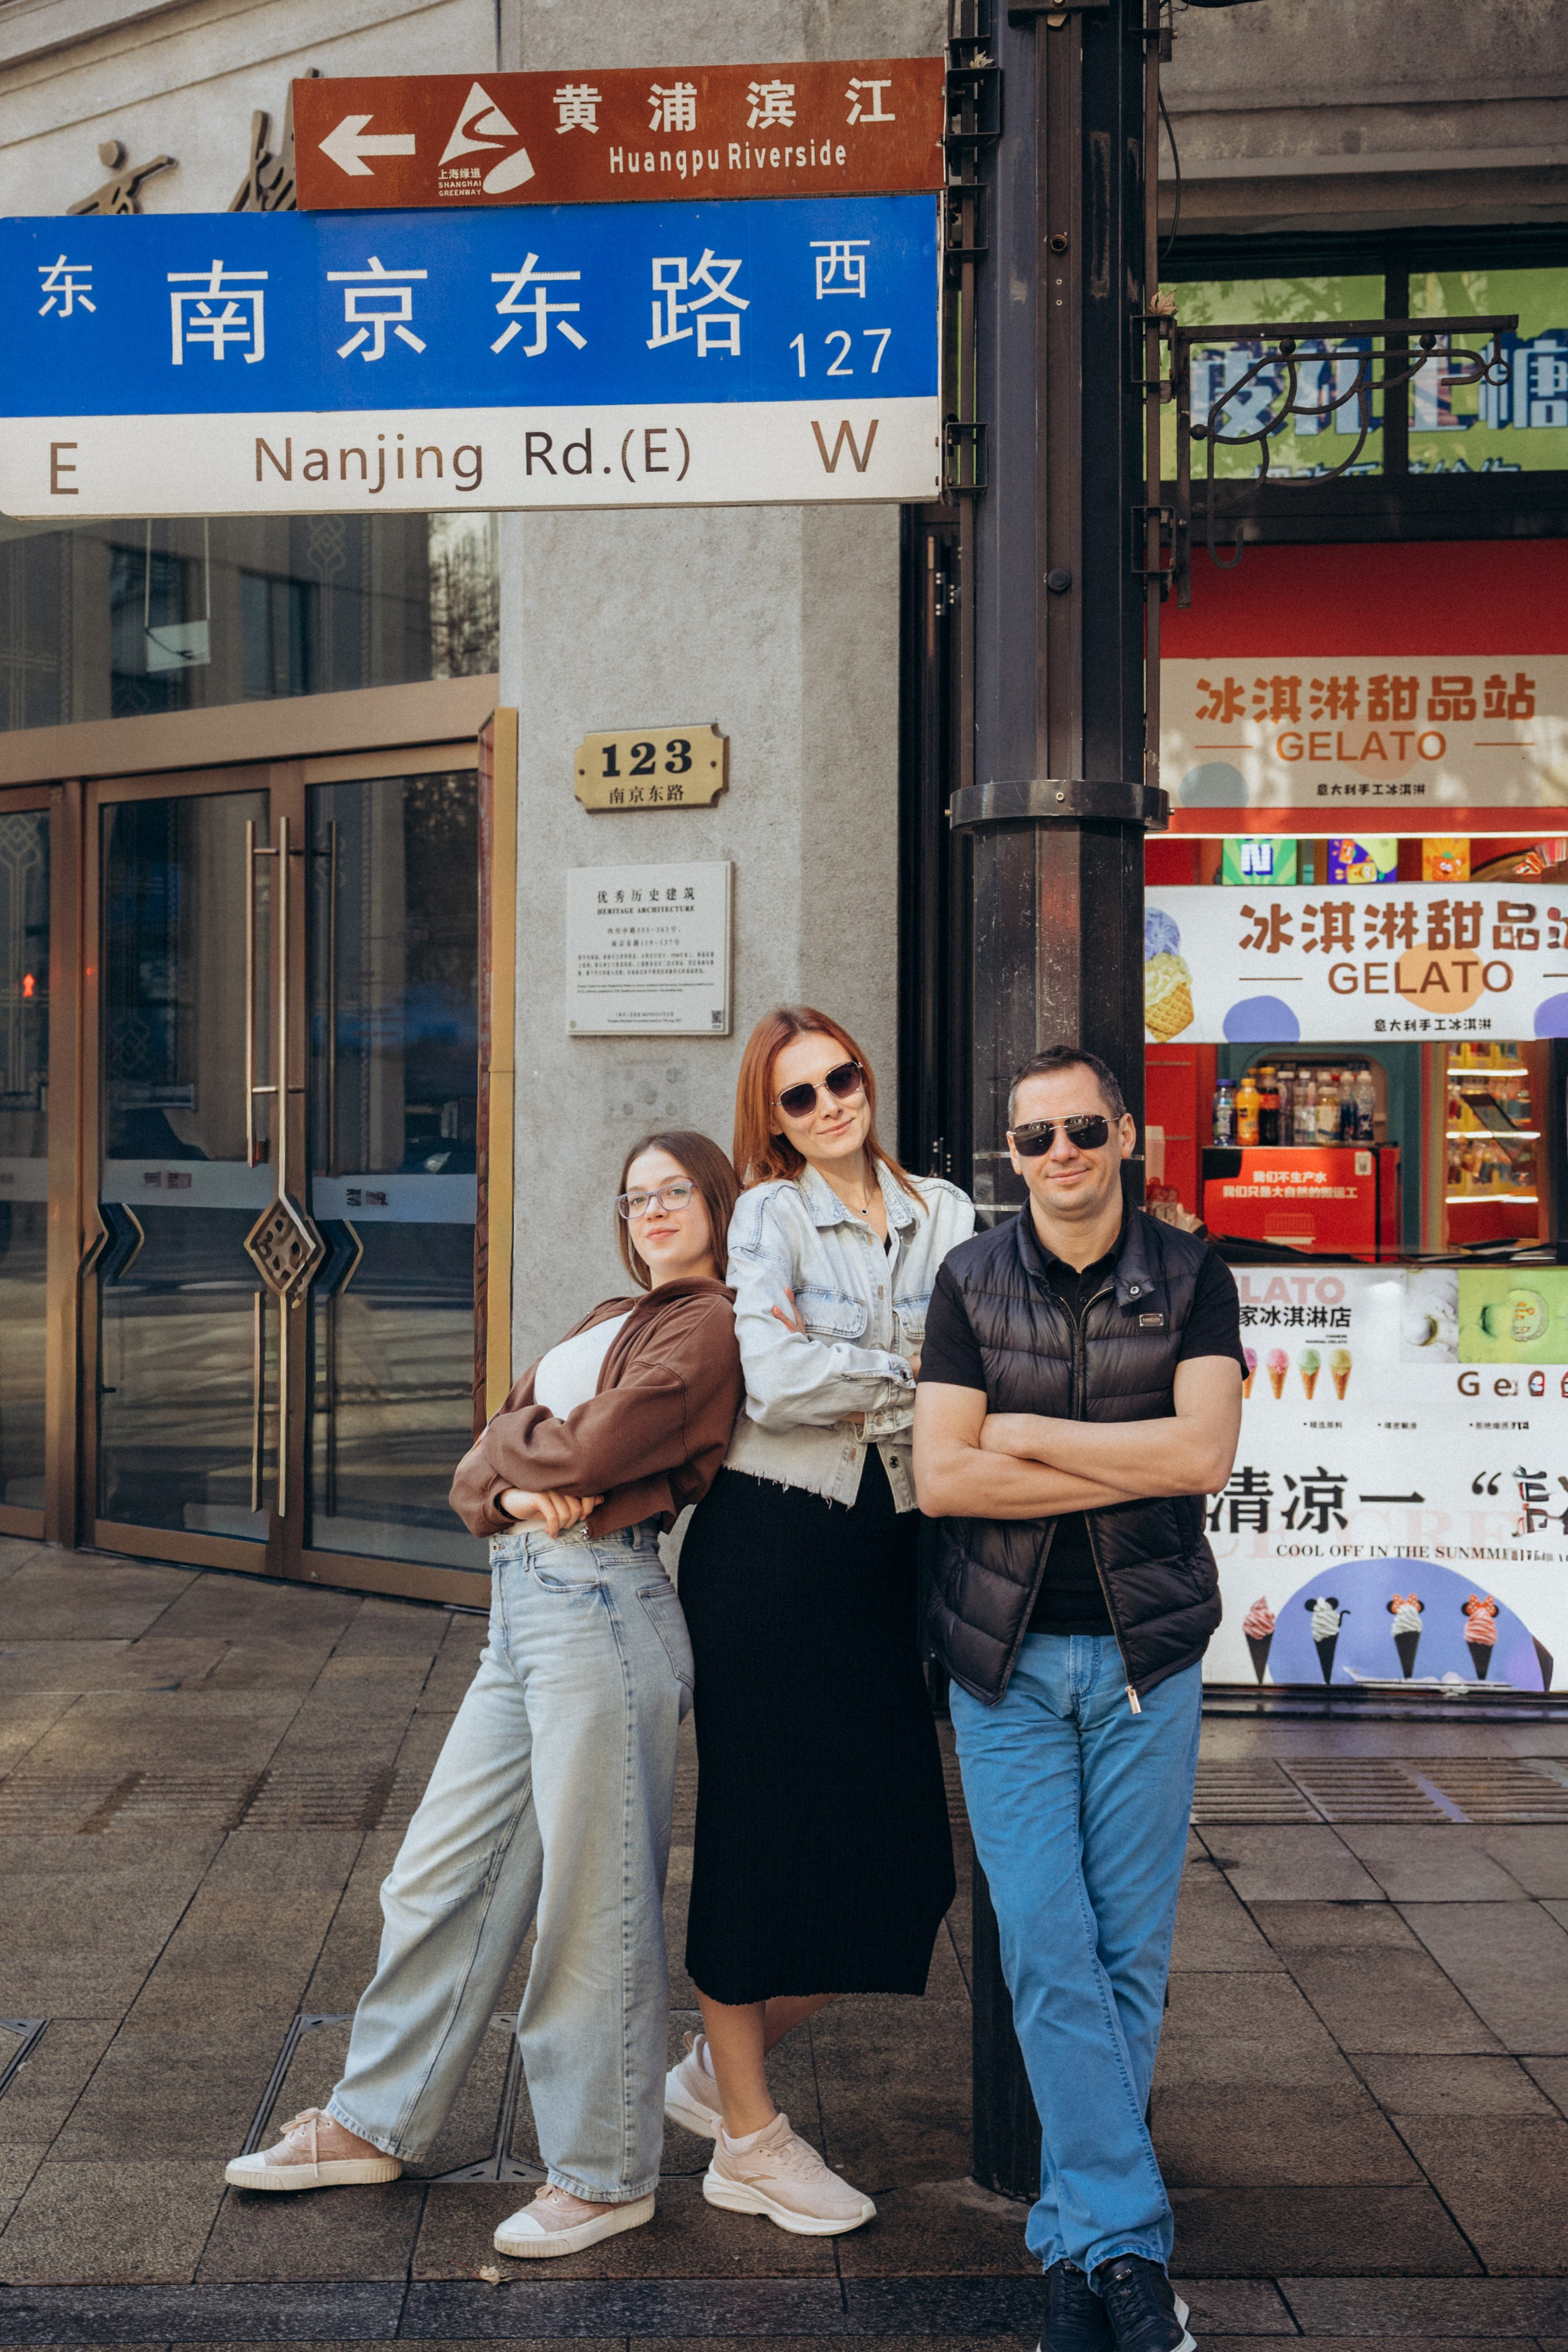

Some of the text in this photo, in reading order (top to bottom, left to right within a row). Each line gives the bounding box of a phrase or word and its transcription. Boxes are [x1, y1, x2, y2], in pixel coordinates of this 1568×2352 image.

[553, 77, 895, 134] 黄浦滨江
[438, 167, 481, 179] 上海绿道
[609, 139, 846, 179] Huangpu Riverside
[38, 239, 870, 366] 东 南京东路 西
[789, 328, 892, 378] 127
[50, 419, 879, 495] E Nanjing Rd.(E) W
[1195, 673, 1536, 724] 冰淇淋甜品站
[602, 739, 693, 777] 123
[1276, 730, 1447, 762] GELATO
[609, 784, 685, 804] 南京东路
[1317, 783, 1426, 796] 意大利手工冰淇淋
[597, 887, 695, 903] 优秀历史建筑
[1328, 960, 1513, 994] GELATO
[1374, 1018, 1492, 1031] 意大利手工冰淇淋
[1233, 1276, 1346, 1305] LATO
[1276, 1544, 1324, 1557] COOL
[1329, 1545, 1364, 1557] OFF
[1370, 1545, 1388, 1558] IN
[1393, 1545, 1430, 1558] THE
